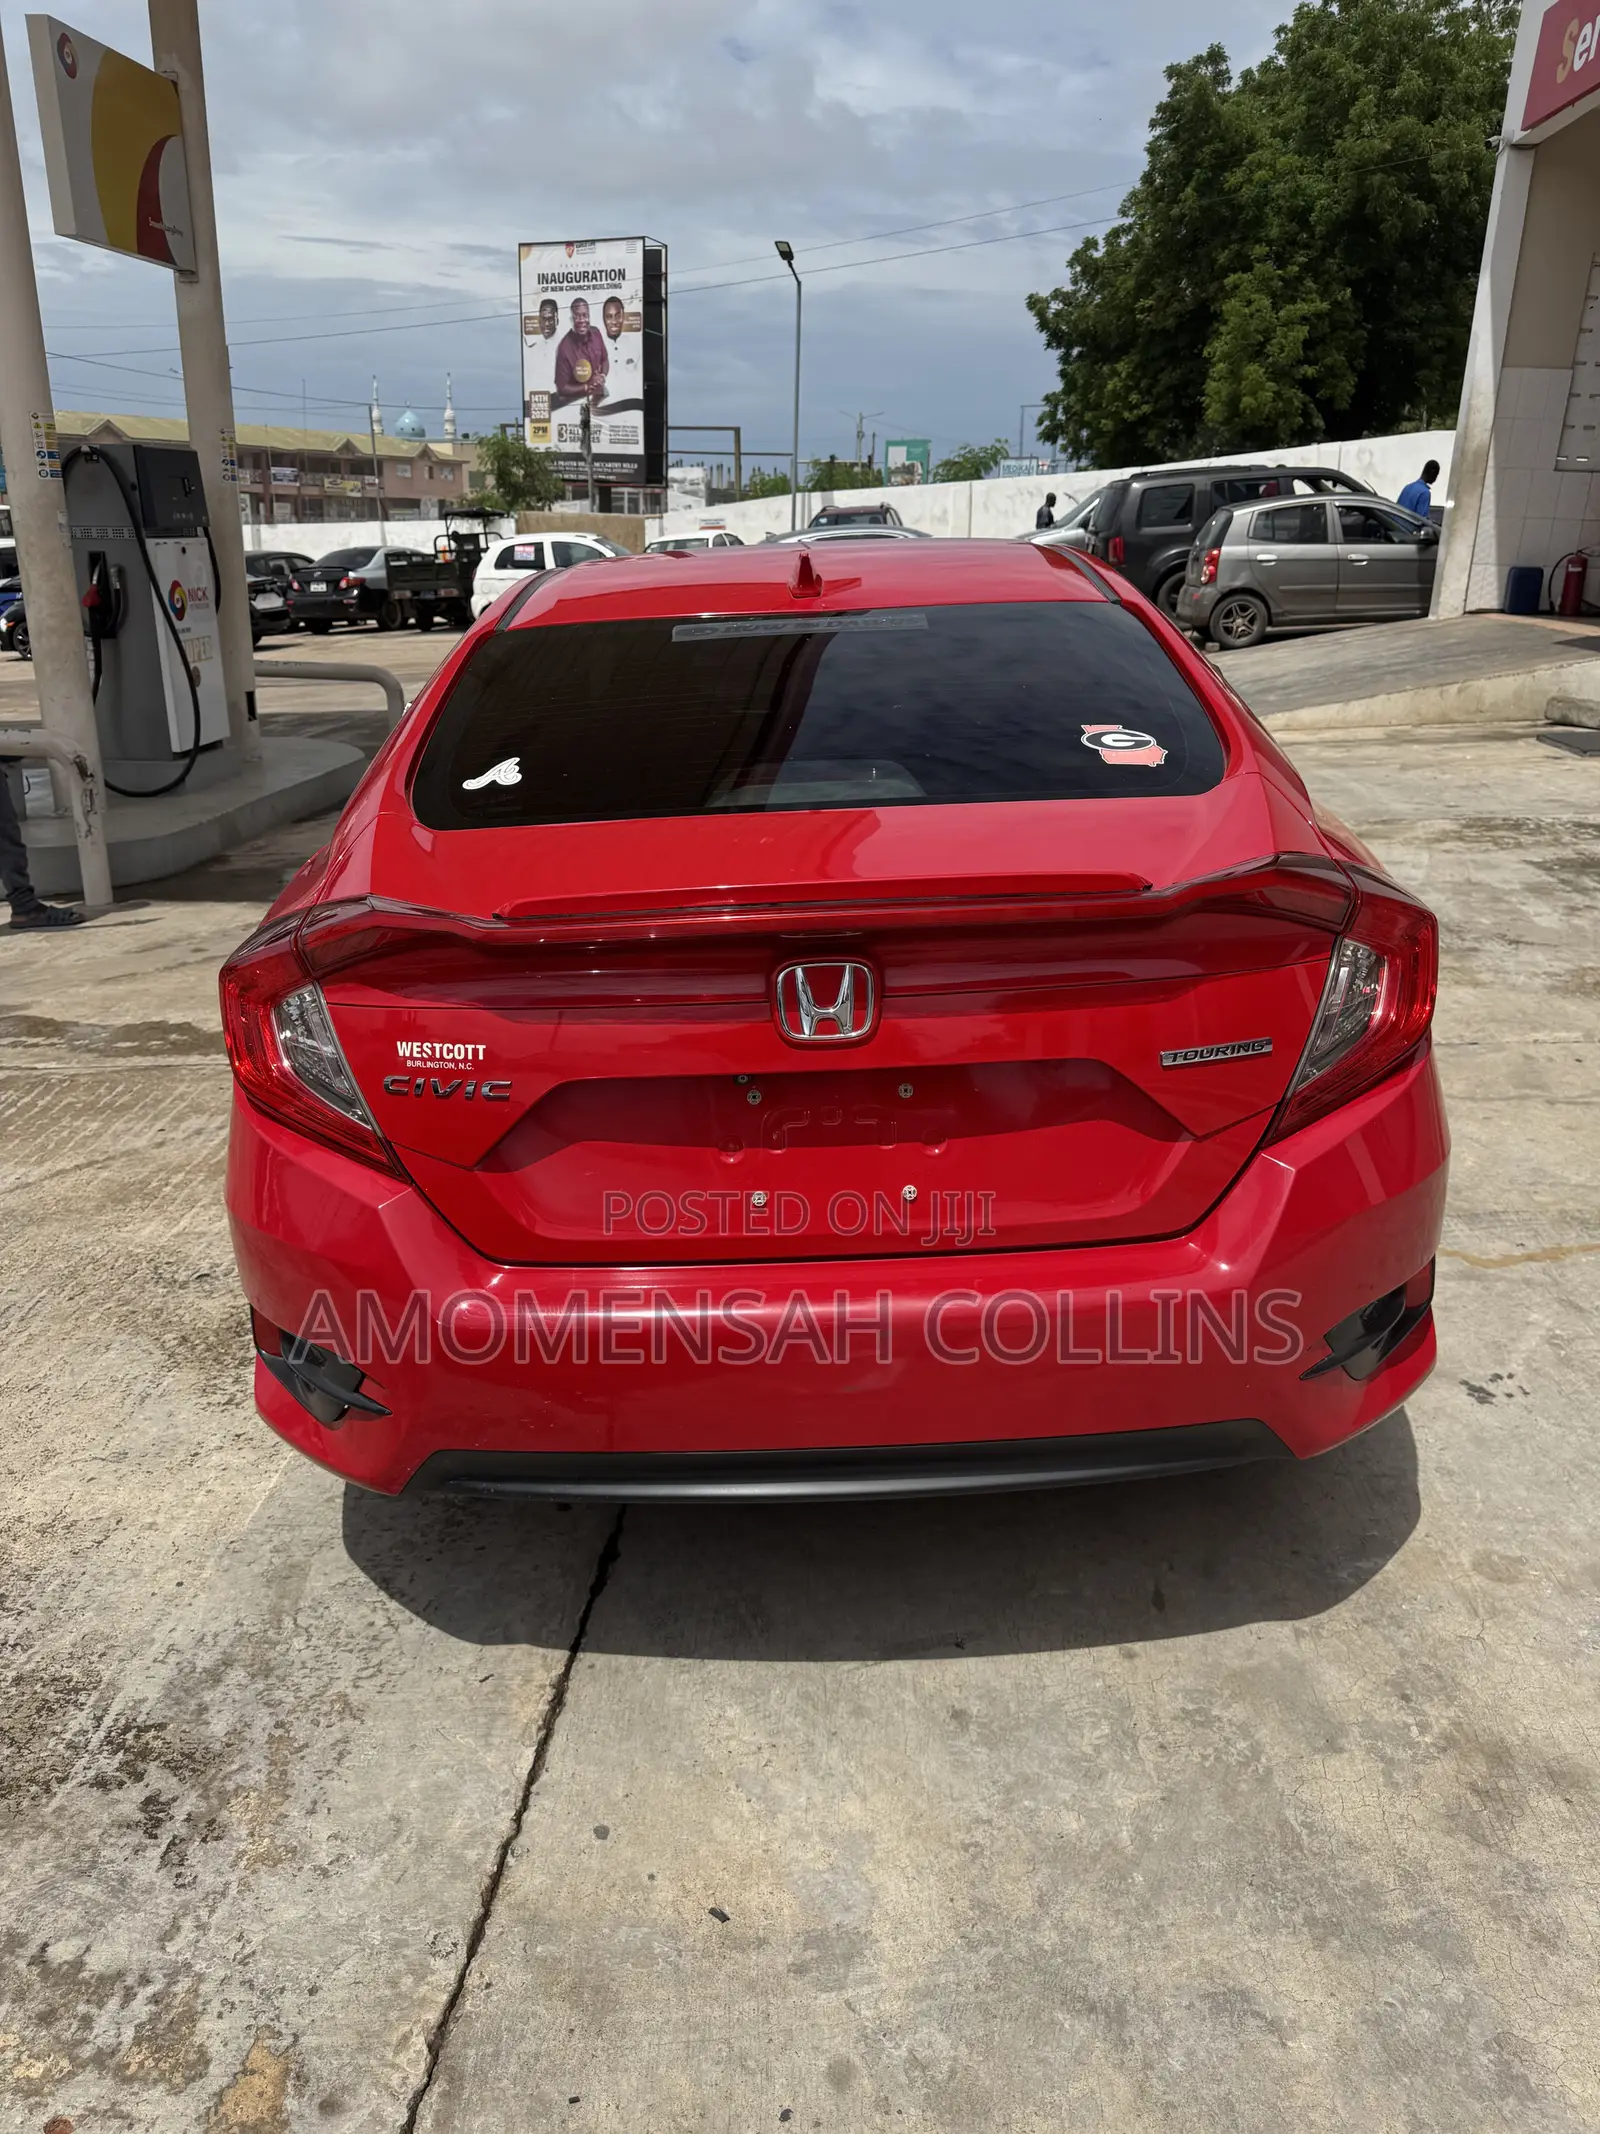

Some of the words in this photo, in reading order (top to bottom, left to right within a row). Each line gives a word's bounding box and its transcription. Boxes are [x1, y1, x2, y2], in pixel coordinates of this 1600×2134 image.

[537, 268, 626, 285] INAUGURATION
[541, 285, 549, 293] OF
[565, 284, 591, 292] CHURCH
[592, 283, 622, 291] BUILDING
[187, 586, 209, 602] NICK
[396, 1041, 486, 1060] WESTCOTT
[1167, 1040, 1266, 1063] TOURING
[406, 1060, 457, 1070] BURLINGTON,
[458, 1062, 474, 1070] N.C.
[383, 1075, 512, 1100] CIVIC
